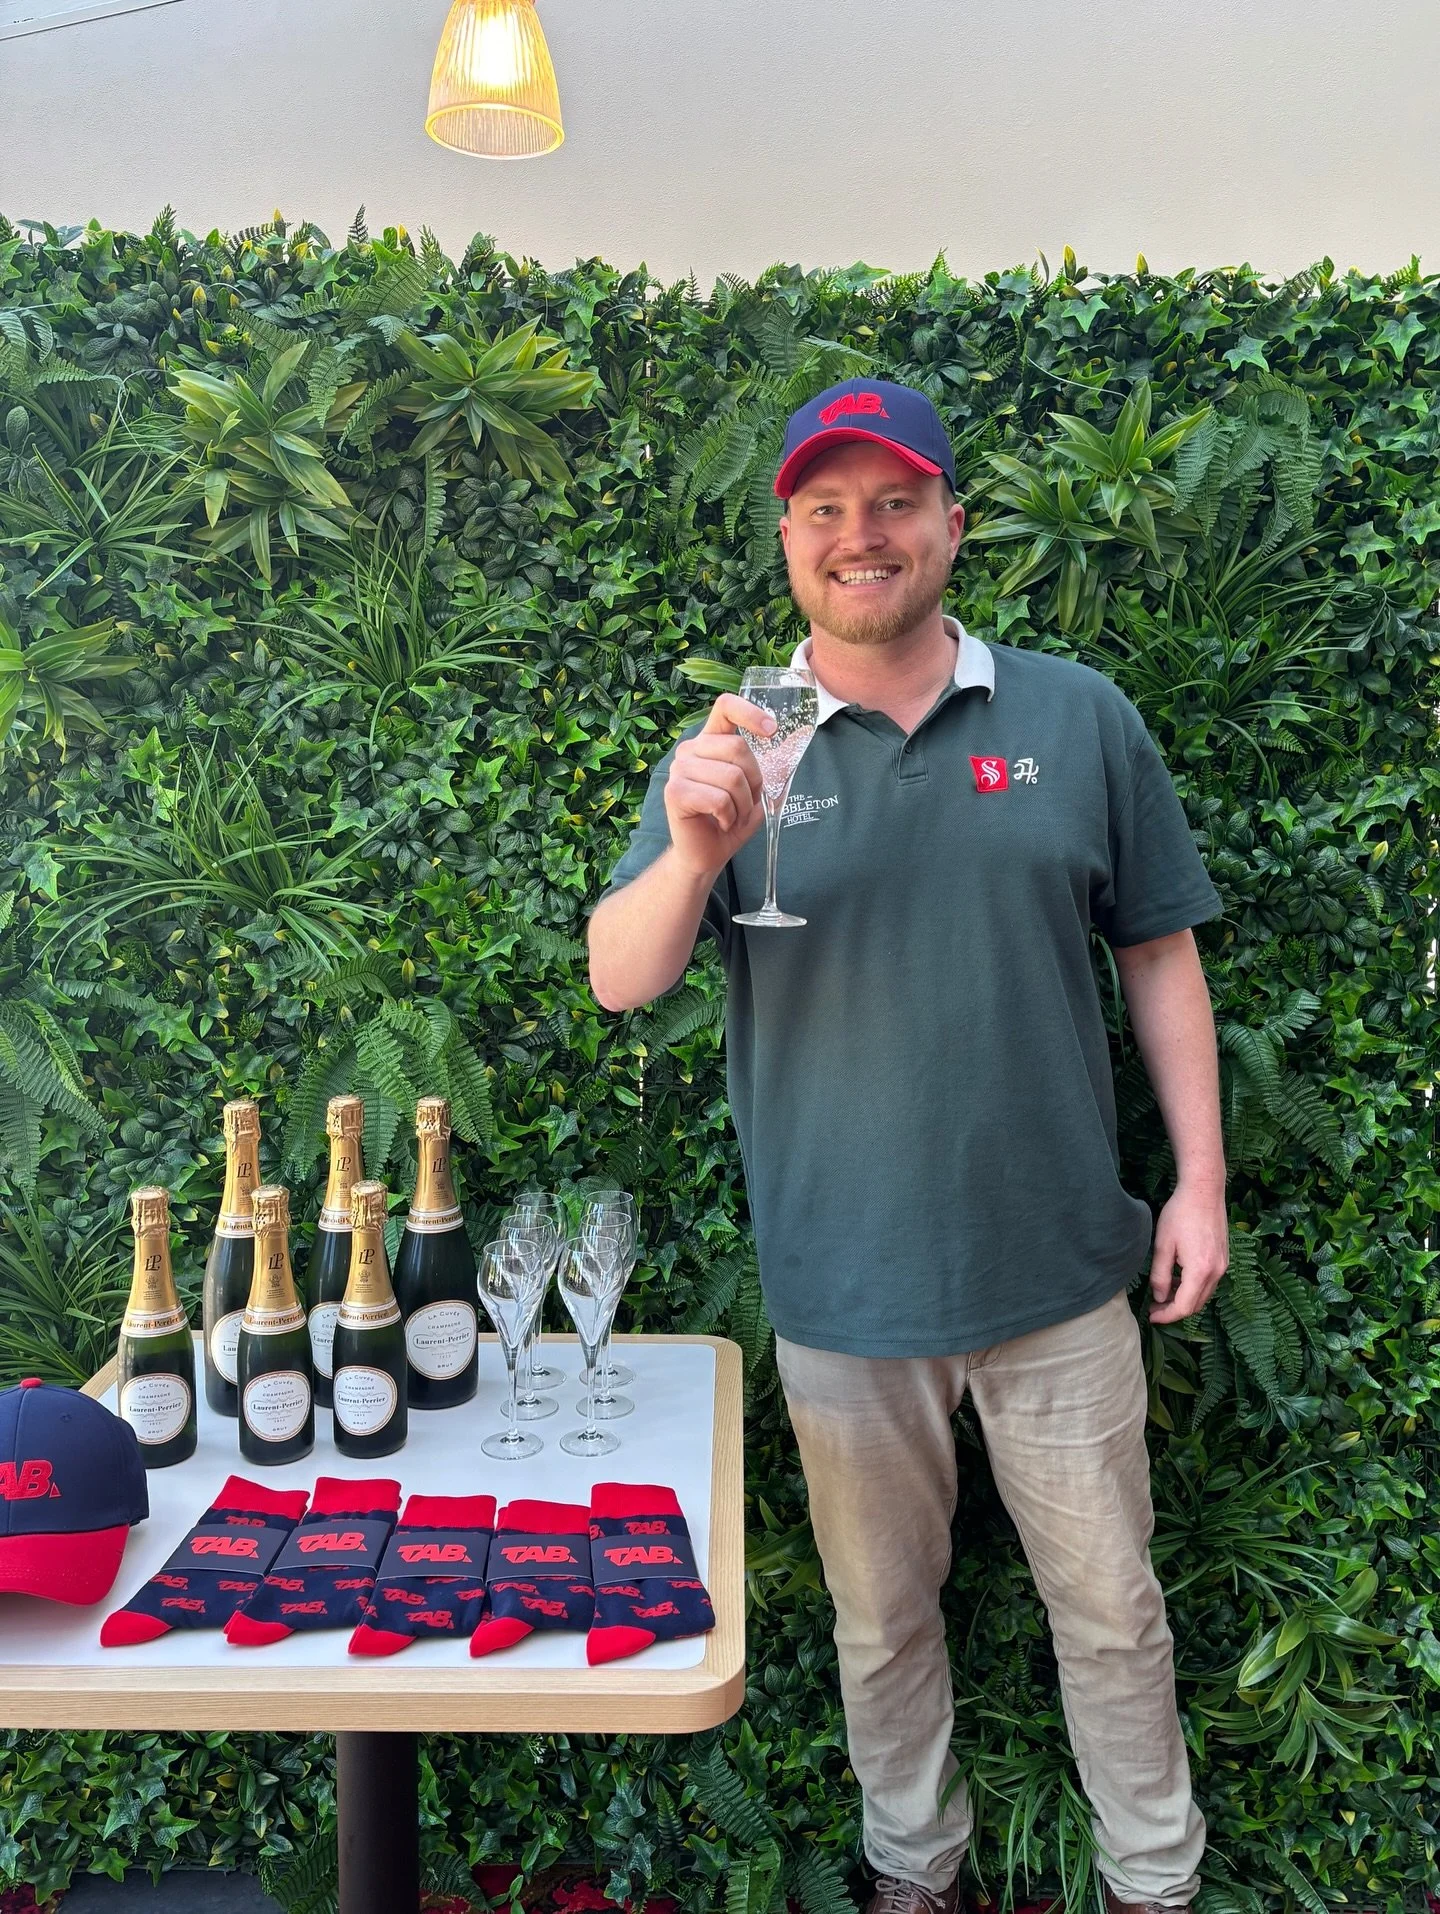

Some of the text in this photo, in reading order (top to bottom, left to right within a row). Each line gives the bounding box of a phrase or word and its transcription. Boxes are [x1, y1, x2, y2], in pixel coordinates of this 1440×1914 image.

[818, 392, 883, 425] TAB
[782, 795, 839, 816] BBLETON
[789, 794, 806, 803] THE
[787, 812, 814, 825] HOTEL
[416, 1332, 470, 1345] Laurent-Perrier
[129, 1402, 182, 1413] Laurent-Perrier
[253, 1398, 303, 1411] Laurent-Perrier
[338, 1394, 386, 1404] Laurent-Perrier
[0, 1460, 53, 1500] AB
[625, 1520, 668, 1536] TAB
[190, 1536, 259, 1558] TAB
[297, 1532, 366, 1553] TAB
[397, 1543, 469, 1563] TAB
[501, 1545, 573, 1564] TAB
[604, 1546, 677, 1567] TAB
[280, 1600, 326, 1614] TAB
[520, 1596, 566, 1617] TAB
[404, 1610, 453, 1628] TAB
